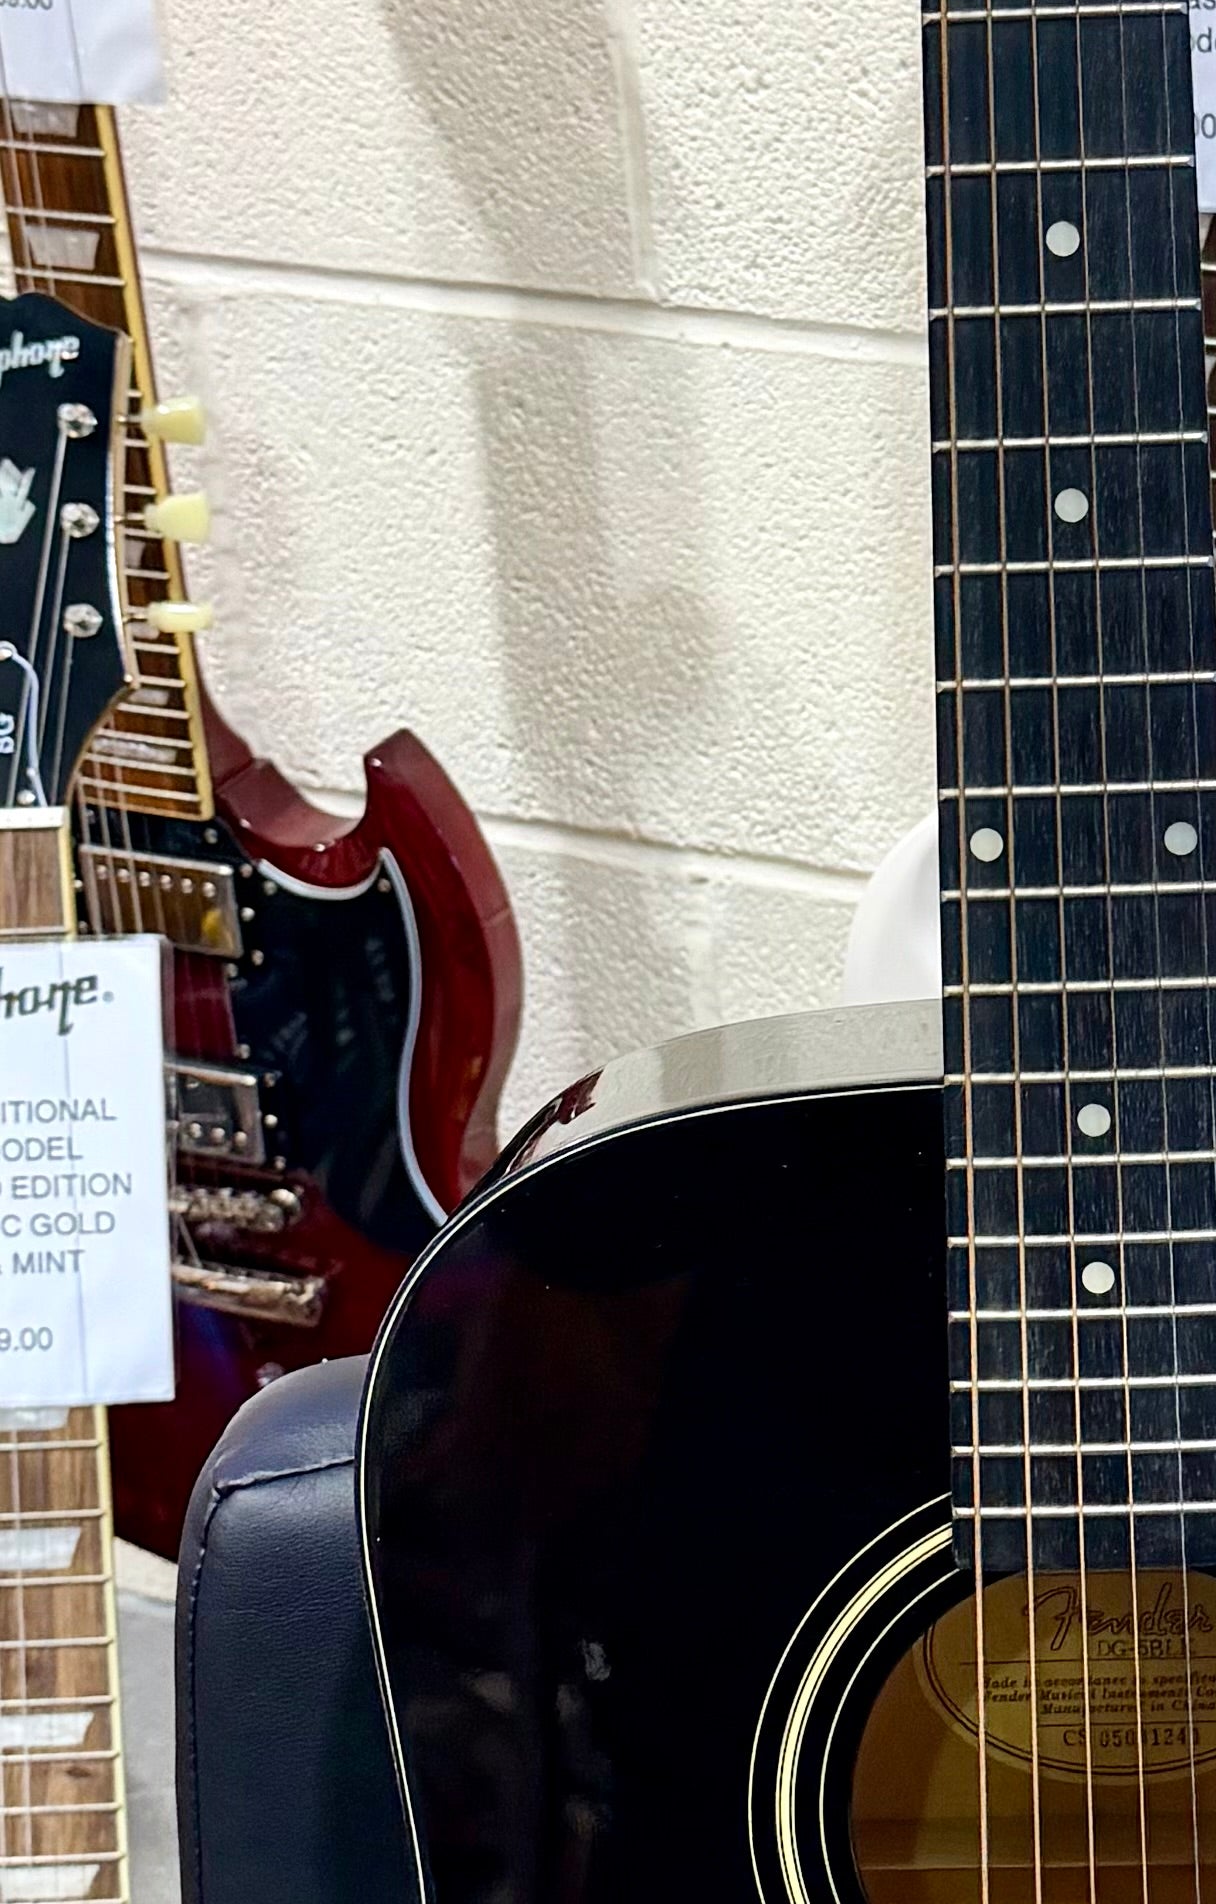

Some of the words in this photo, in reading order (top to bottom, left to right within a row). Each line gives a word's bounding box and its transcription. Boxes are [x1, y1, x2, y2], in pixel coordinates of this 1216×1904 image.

[0, 1136, 84, 1163] ODEL
[11, 1172, 133, 1200] EDITION
[30, 1211, 116, 1237] GOLD
[12, 1249, 85, 1275] MINT
[1023, 1582, 1214, 1652] Fender
